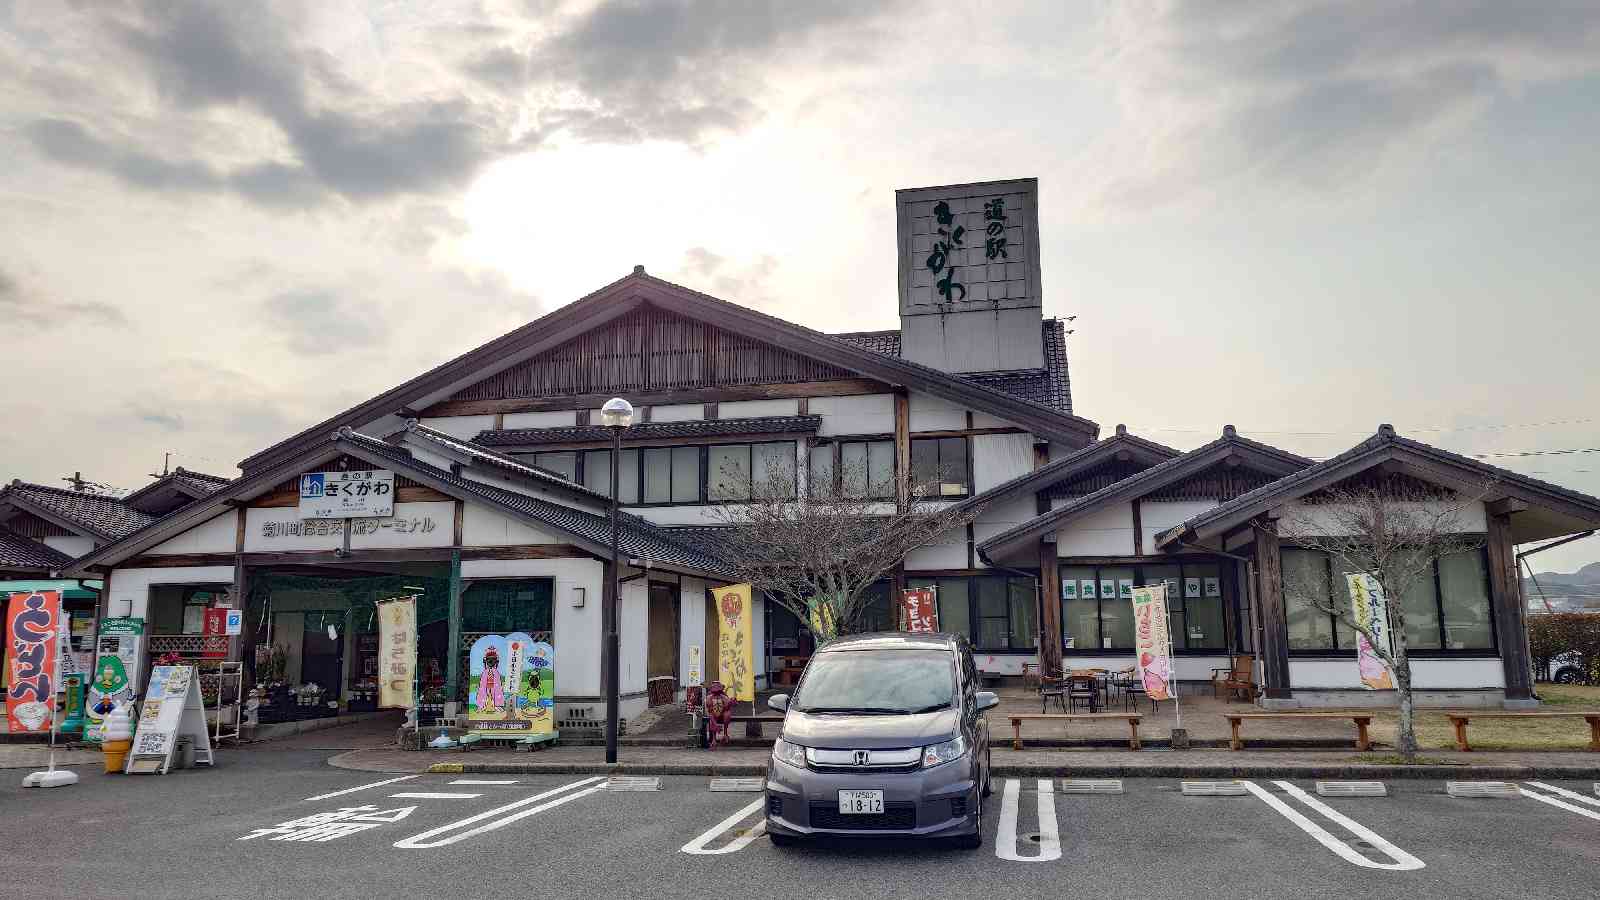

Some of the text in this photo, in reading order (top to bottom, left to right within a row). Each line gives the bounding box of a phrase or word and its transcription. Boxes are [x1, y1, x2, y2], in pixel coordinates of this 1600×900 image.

[983, 197, 1008, 260] 道の駅
[926, 200, 966, 304] きくがわ
[324, 481, 390, 498] きくがわ
[262, 517, 436, 538] 菊川町総合交流ターミナル
[850, 799, 881, 812] 18-12
